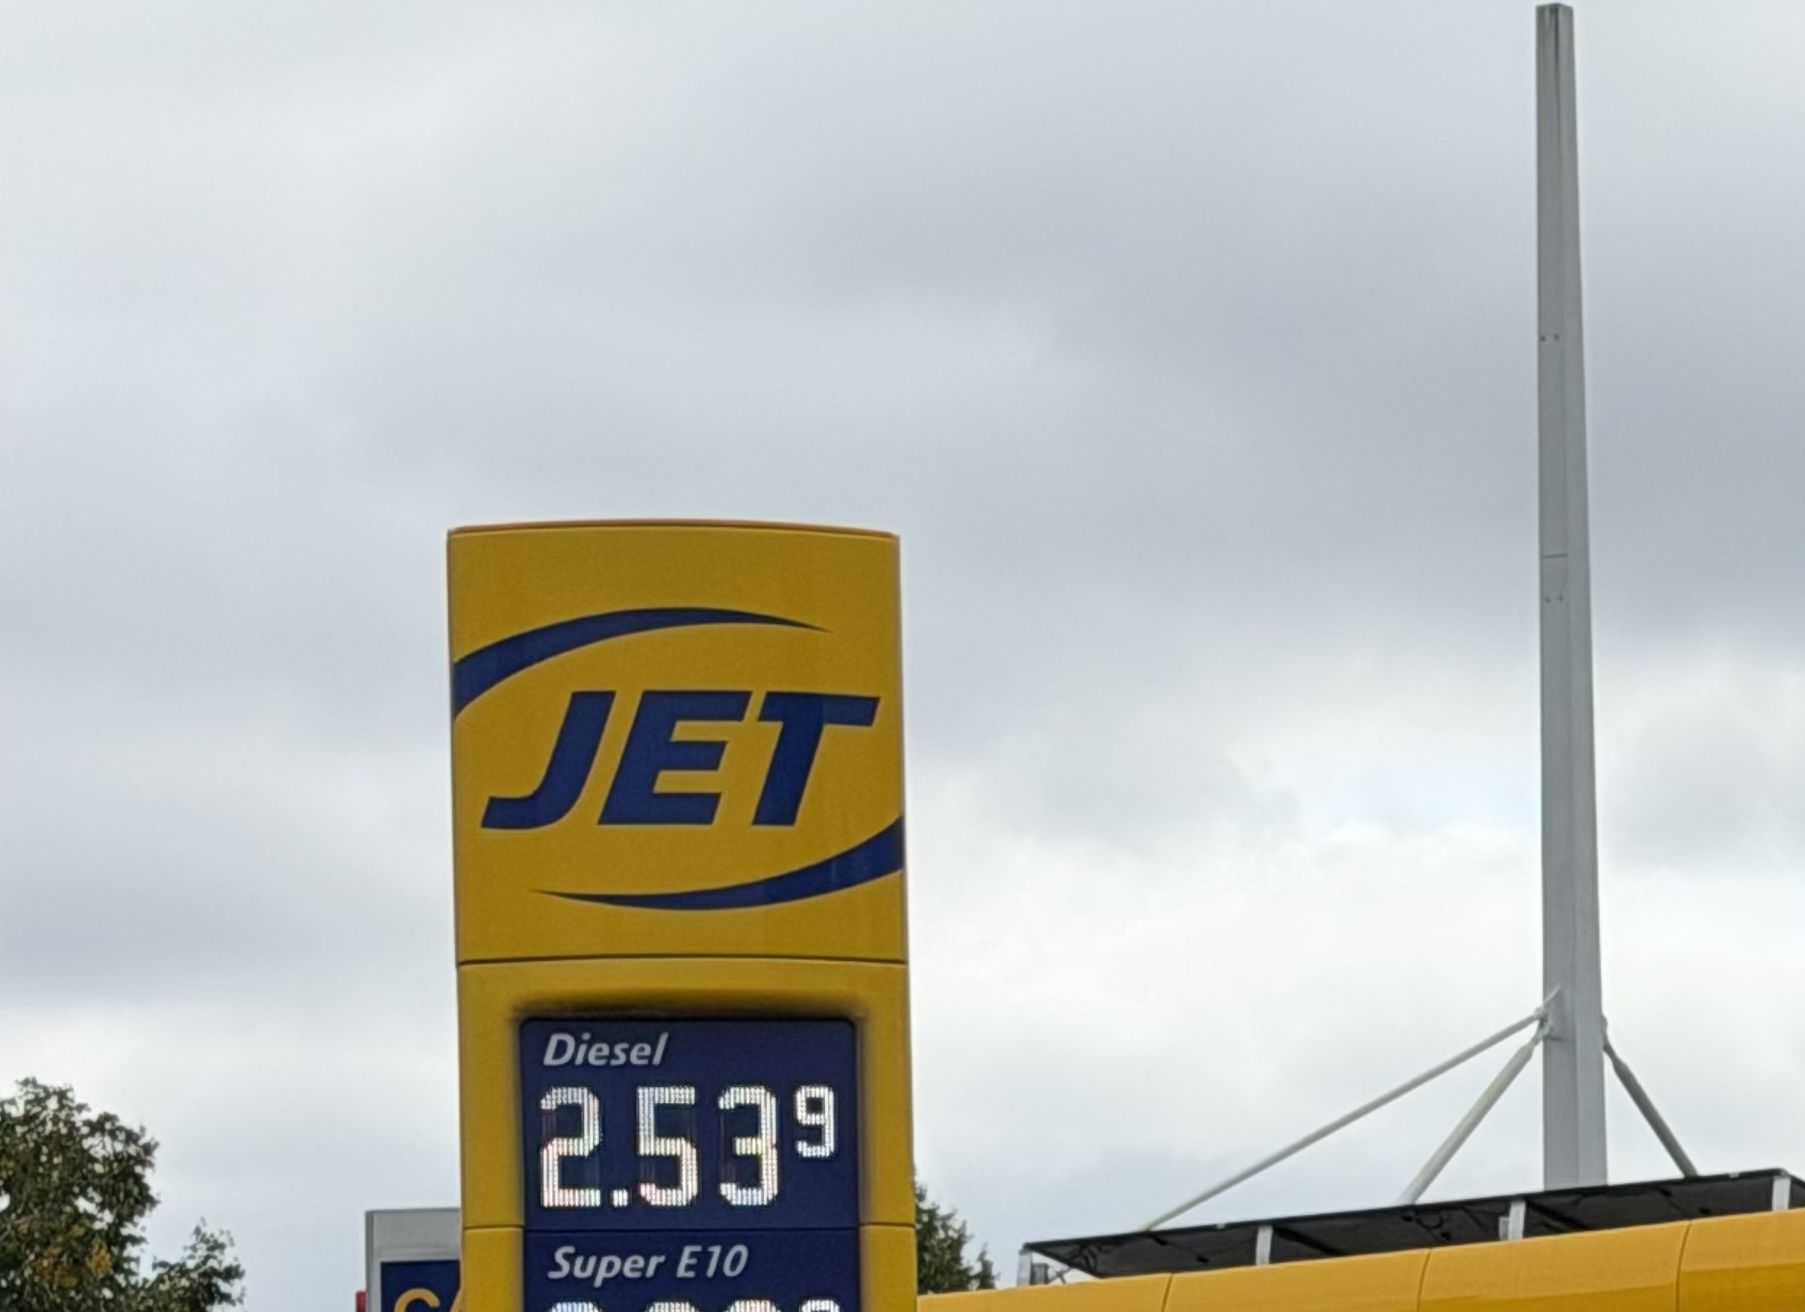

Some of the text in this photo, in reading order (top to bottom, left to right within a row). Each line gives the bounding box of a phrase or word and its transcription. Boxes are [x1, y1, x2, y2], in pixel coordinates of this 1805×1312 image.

[481, 690, 881, 829] JET
[542, 1032, 669, 1068] Diesel
[547, 1244, 749, 1287] Super E10
